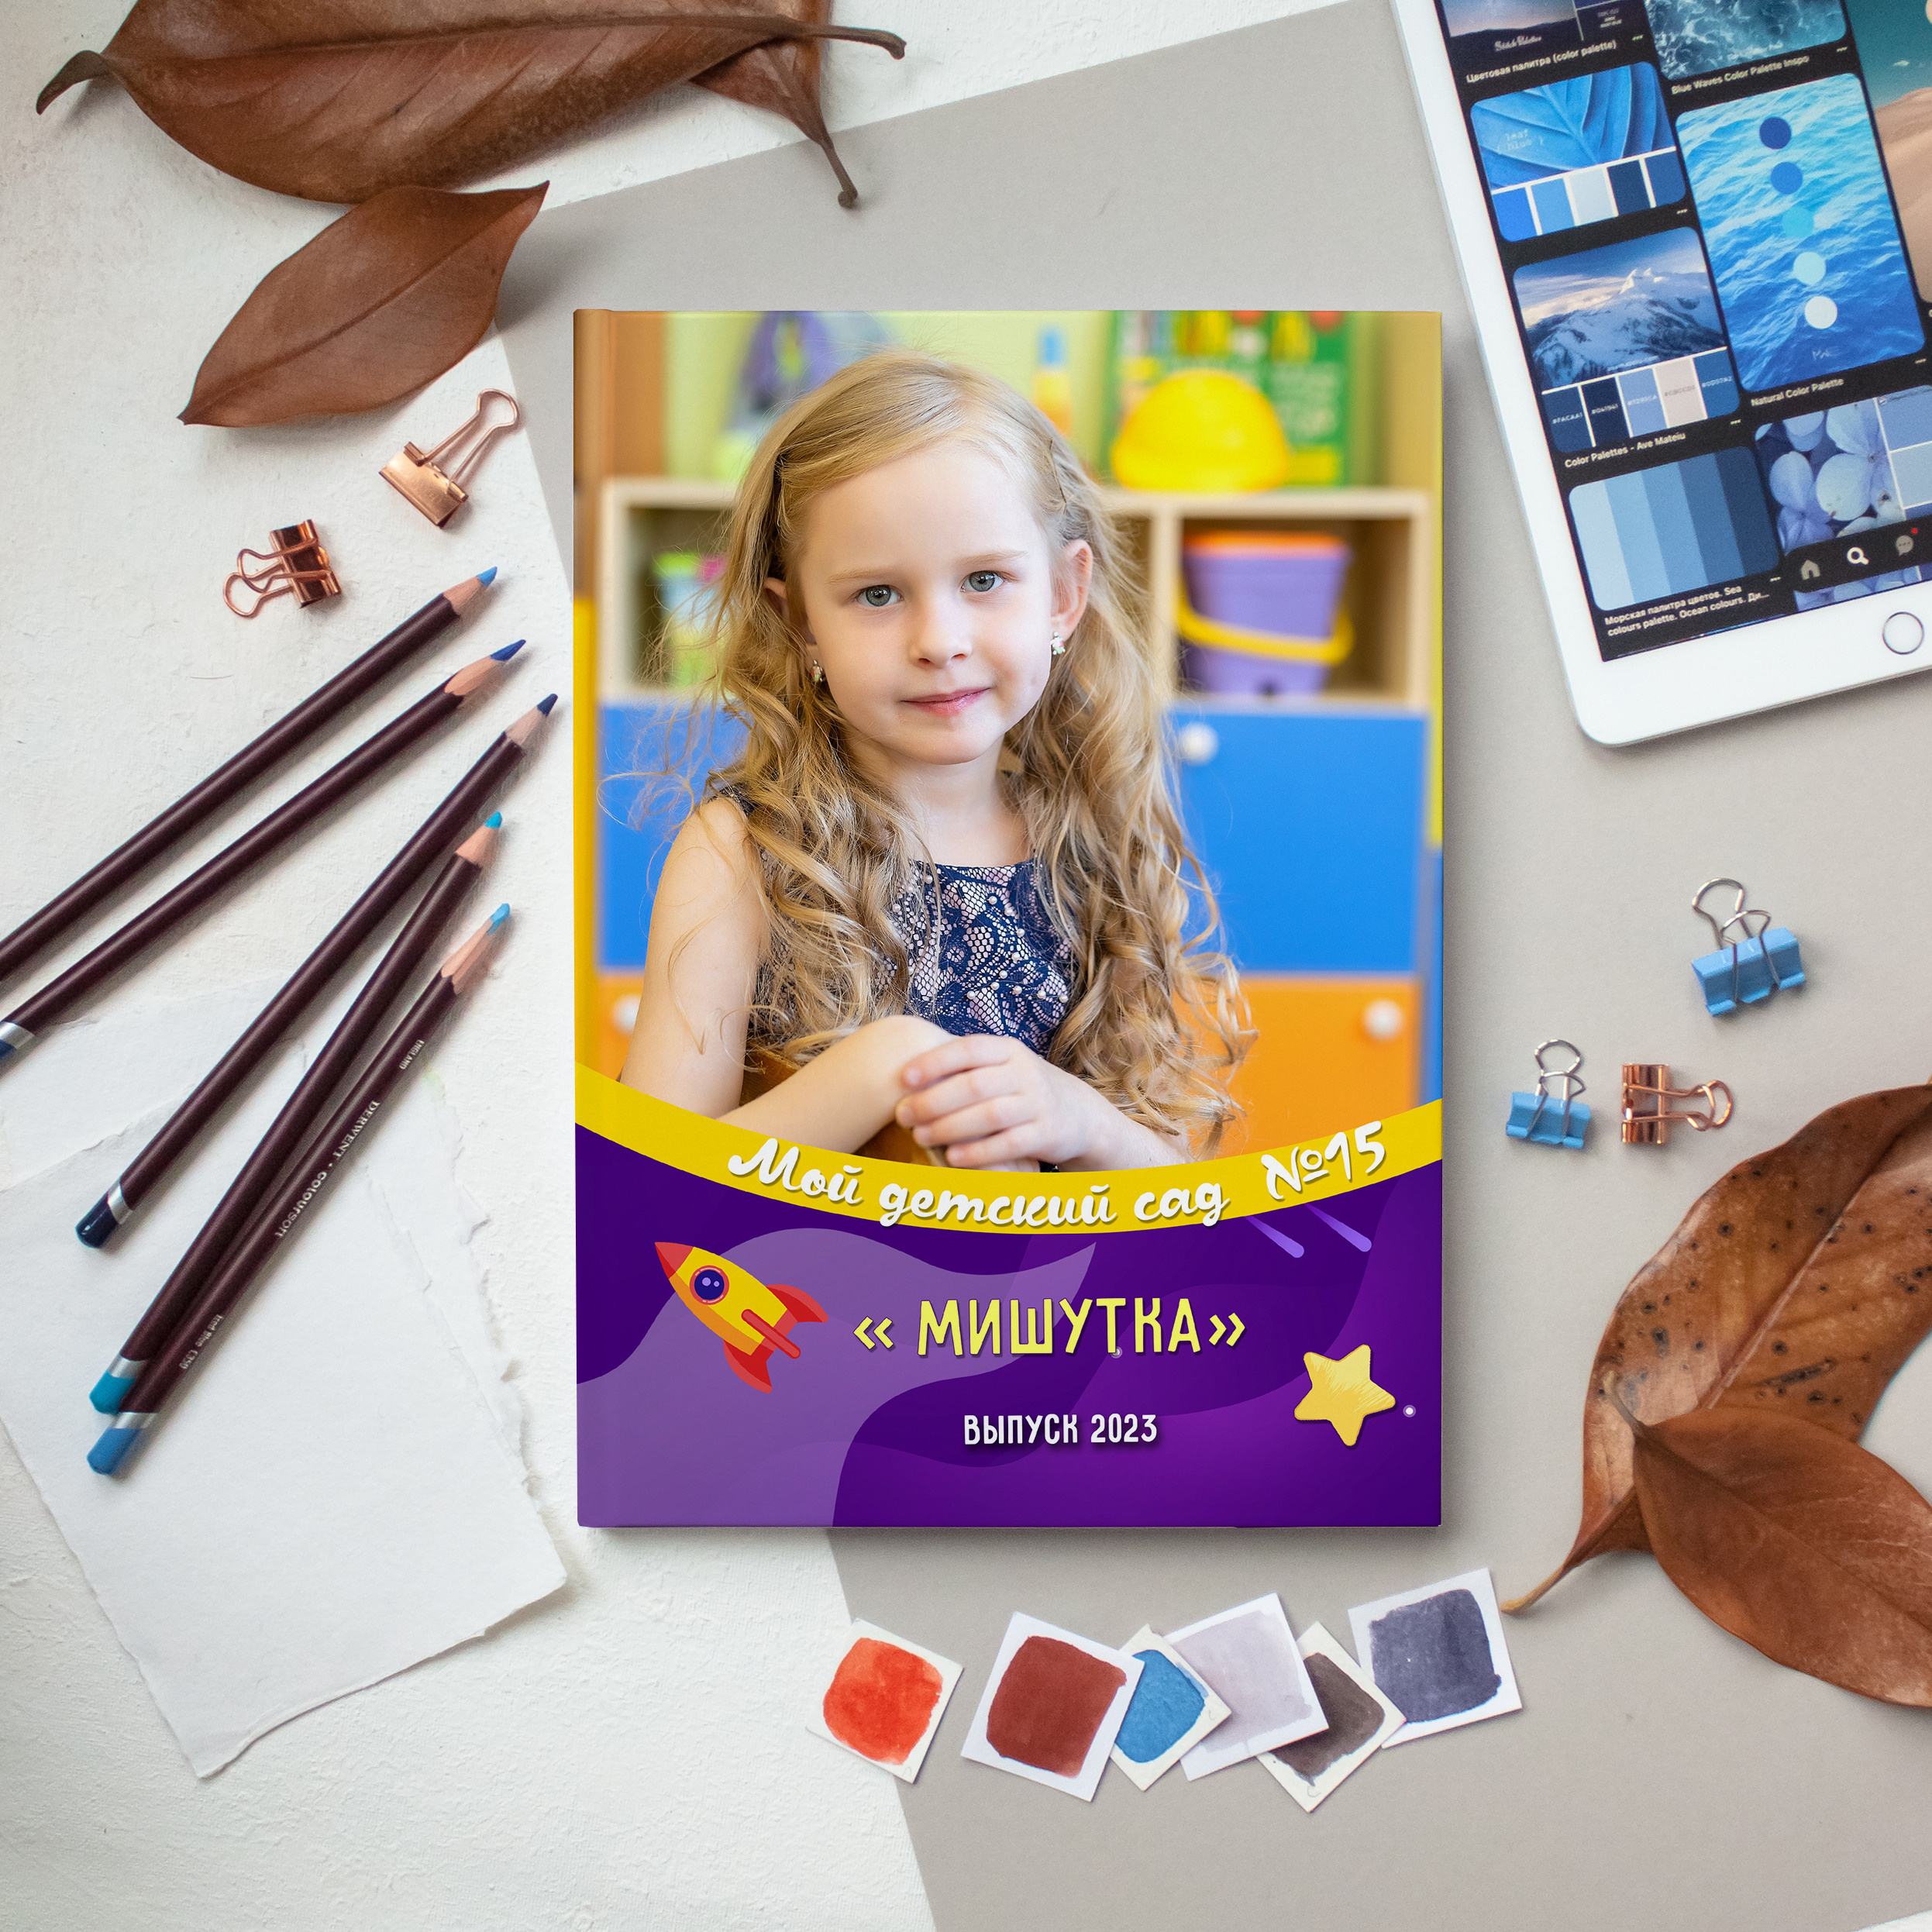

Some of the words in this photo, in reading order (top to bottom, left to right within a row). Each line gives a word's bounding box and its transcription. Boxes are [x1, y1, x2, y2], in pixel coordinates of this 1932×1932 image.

[1465, 64, 1511, 84] Цветовая
[1511, 57, 1551, 73] палитра
[1552, 49, 1579, 64] (color
[1580, 40, 1617, 57] palette)
[1671, 82, 1693, 95] Blue
[1693, 76, 1724, 90] Waves
[1724, 69, 1749, 82] Color
[1749, 61, 1782, 76] Palette
[1782, 54, 1810, 69] Inspo
[1750, 391, 1785, 407] Natural
[1785, 385, 1810, 398] Color
[1810, 377, 1844, 392] Palette
[1564, 455, 1589, 468] Color
[1590, 446, 1629, 462] Palettes
[1636, 439, 1654, 451] Ave
[1654, 431, 1686, 446] Mateiu
[1604, 608, 1647, 625] Морская
[1647, 599, 1686, 615] палитра
[1687, 591, 1723, 605] цветов.
[1724, 585, 1742, 596] Sea
[1607, 622, 1642, 637] colours
[1642, 613, 1678, 629] palette.
[1679, 604, 1709, 618] Ocean
[1709, 597, 1747, 611] colours.
[333, 1100, 381, 1160] DERWENT
[728, 1138, 863, 1204] Мой
[879, 1183, 1117, 1227] детский
[1134, 1183, 1231, 1227] сад
[1260, 1120, 1386, 1200] №15
[964, 1414, 1078, 1445] ВЫПУСК
[1090, 1413, 1157, 1443] 2023
